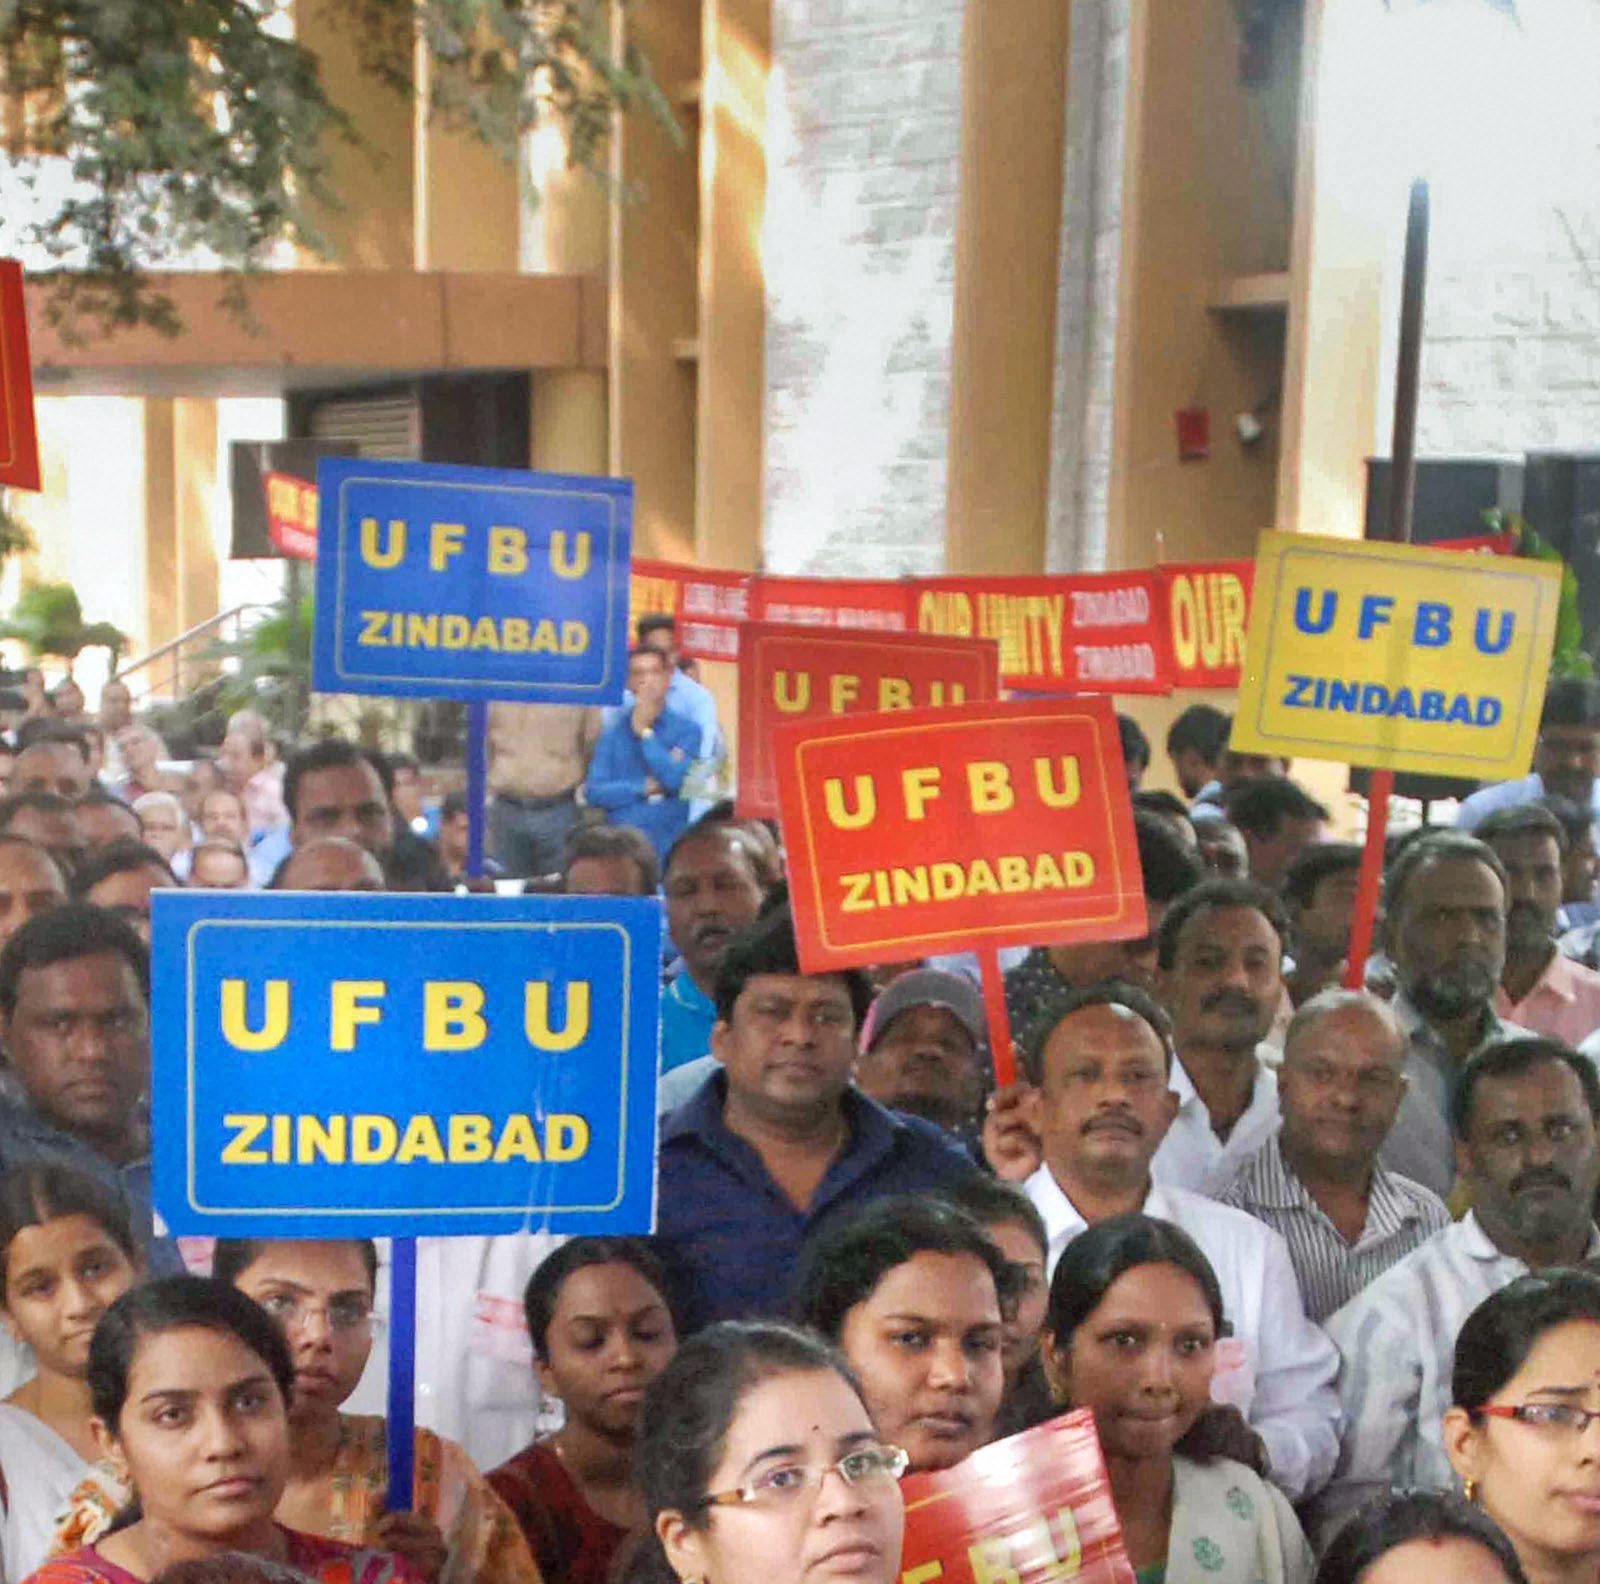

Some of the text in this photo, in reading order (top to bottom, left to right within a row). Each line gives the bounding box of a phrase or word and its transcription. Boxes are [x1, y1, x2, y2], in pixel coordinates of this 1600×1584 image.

[360, 517, 593, 580] UFBU
[358, 608, 590, 656] ZINDABAD
[1169, 572, 1248, 669] OUR
[1293, 585, 1517, 656] UFBU
[1282, 674, 1504, 730] ZINDABAD
[822, 755, 1084, 832] UFBU
[838, 849, 1096, 914] ZINDABAD
[220, 978, 592, 1052] UFBU
[220, 1112, 592, 1165] ZINDABAD
